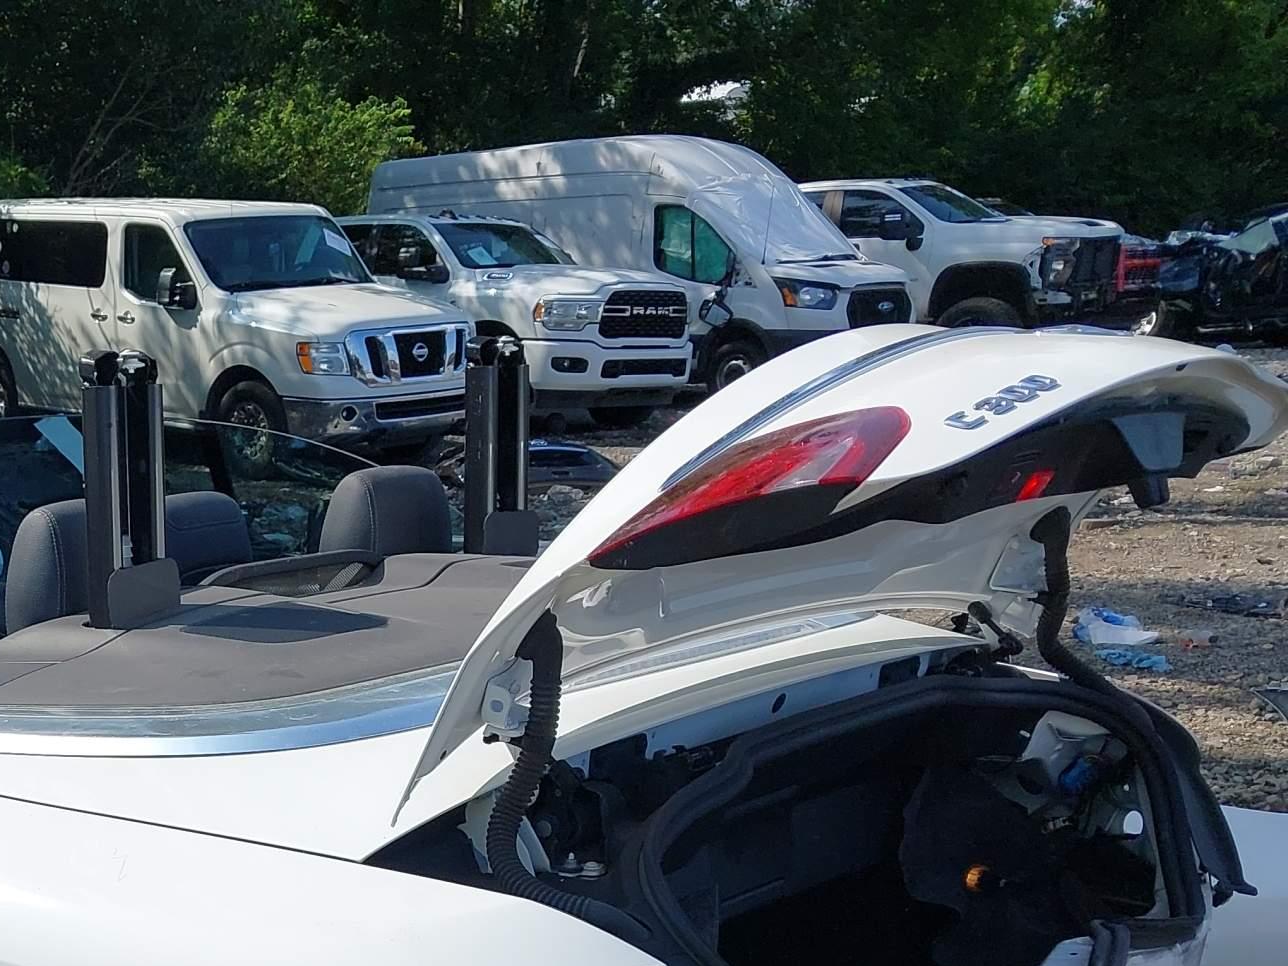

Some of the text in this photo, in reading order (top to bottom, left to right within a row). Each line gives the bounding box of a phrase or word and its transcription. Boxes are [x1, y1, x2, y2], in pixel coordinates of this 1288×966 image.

[632, 306, 671, 316] RAM
[943, 374, 1062, 430] C 300
